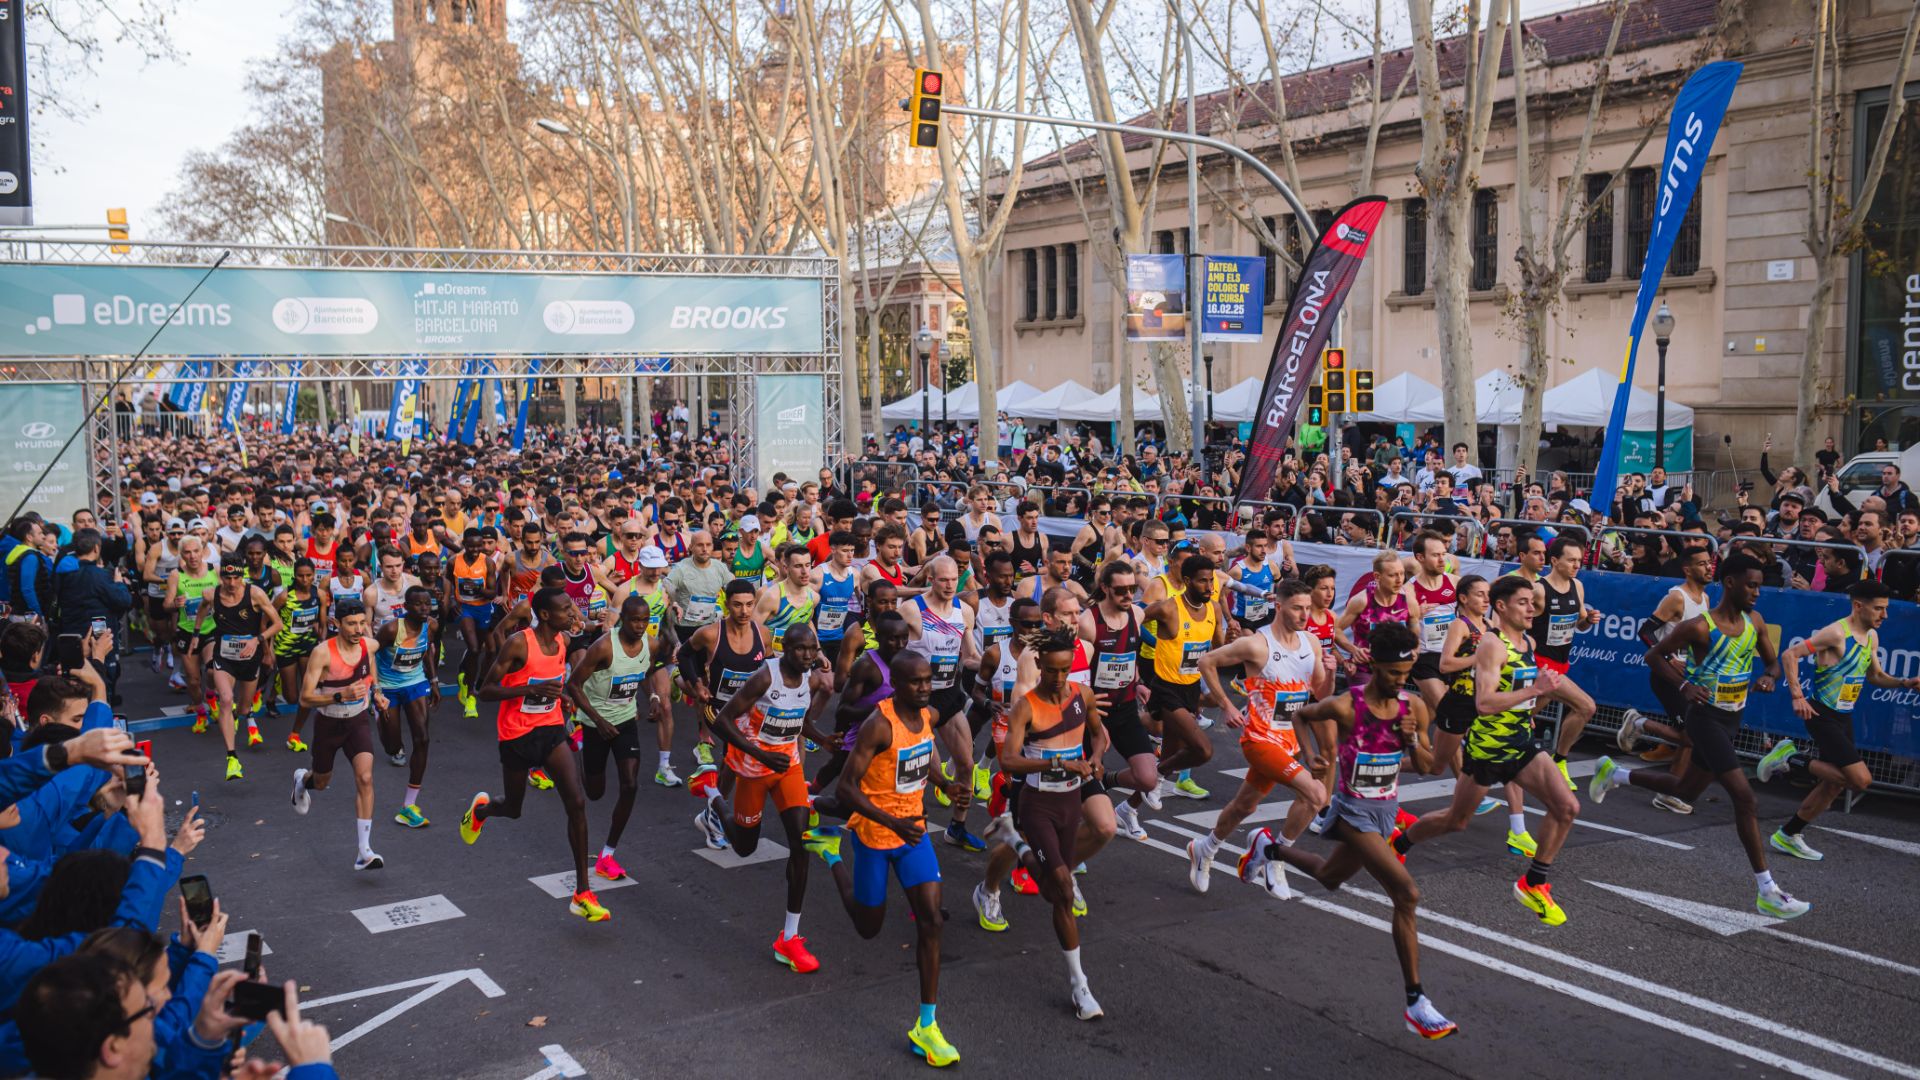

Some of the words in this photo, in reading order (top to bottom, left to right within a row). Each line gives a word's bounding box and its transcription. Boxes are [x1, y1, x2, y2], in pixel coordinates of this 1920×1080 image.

[1208, 262, 1237, 272] BATEGA
[1208, 273, 1224, 282] AMB
[1227, 273, 1240, 283] ELS
[438, 283, 487, 295] eDreams
[1208, 283, 1238, 293] COLORS
[1240, 284, 1250, 294] DE
[1207, 293, 1217, 302] LA
[1219, 293, 1244, 303] CURSA
[94, 295, 231, 325] eDreams
[414, 300, 456, 315] MITJA
[463, 298, 519, 315] MARATÓ
[1207, 304, 1244, 314] 16.02.25
[314, 315, 364, 324] Barcelona
[579, 316, 623, 324] Barcelona
[670, 306, 789, 330] BROOKS
[415, 318, 498, 333] BARCELONA
[425, 335, 463, 344] BROOKS
[1266, 270, 1330, 428] BARCELONA
[15, 440, 64, 449] HYUNDAI
